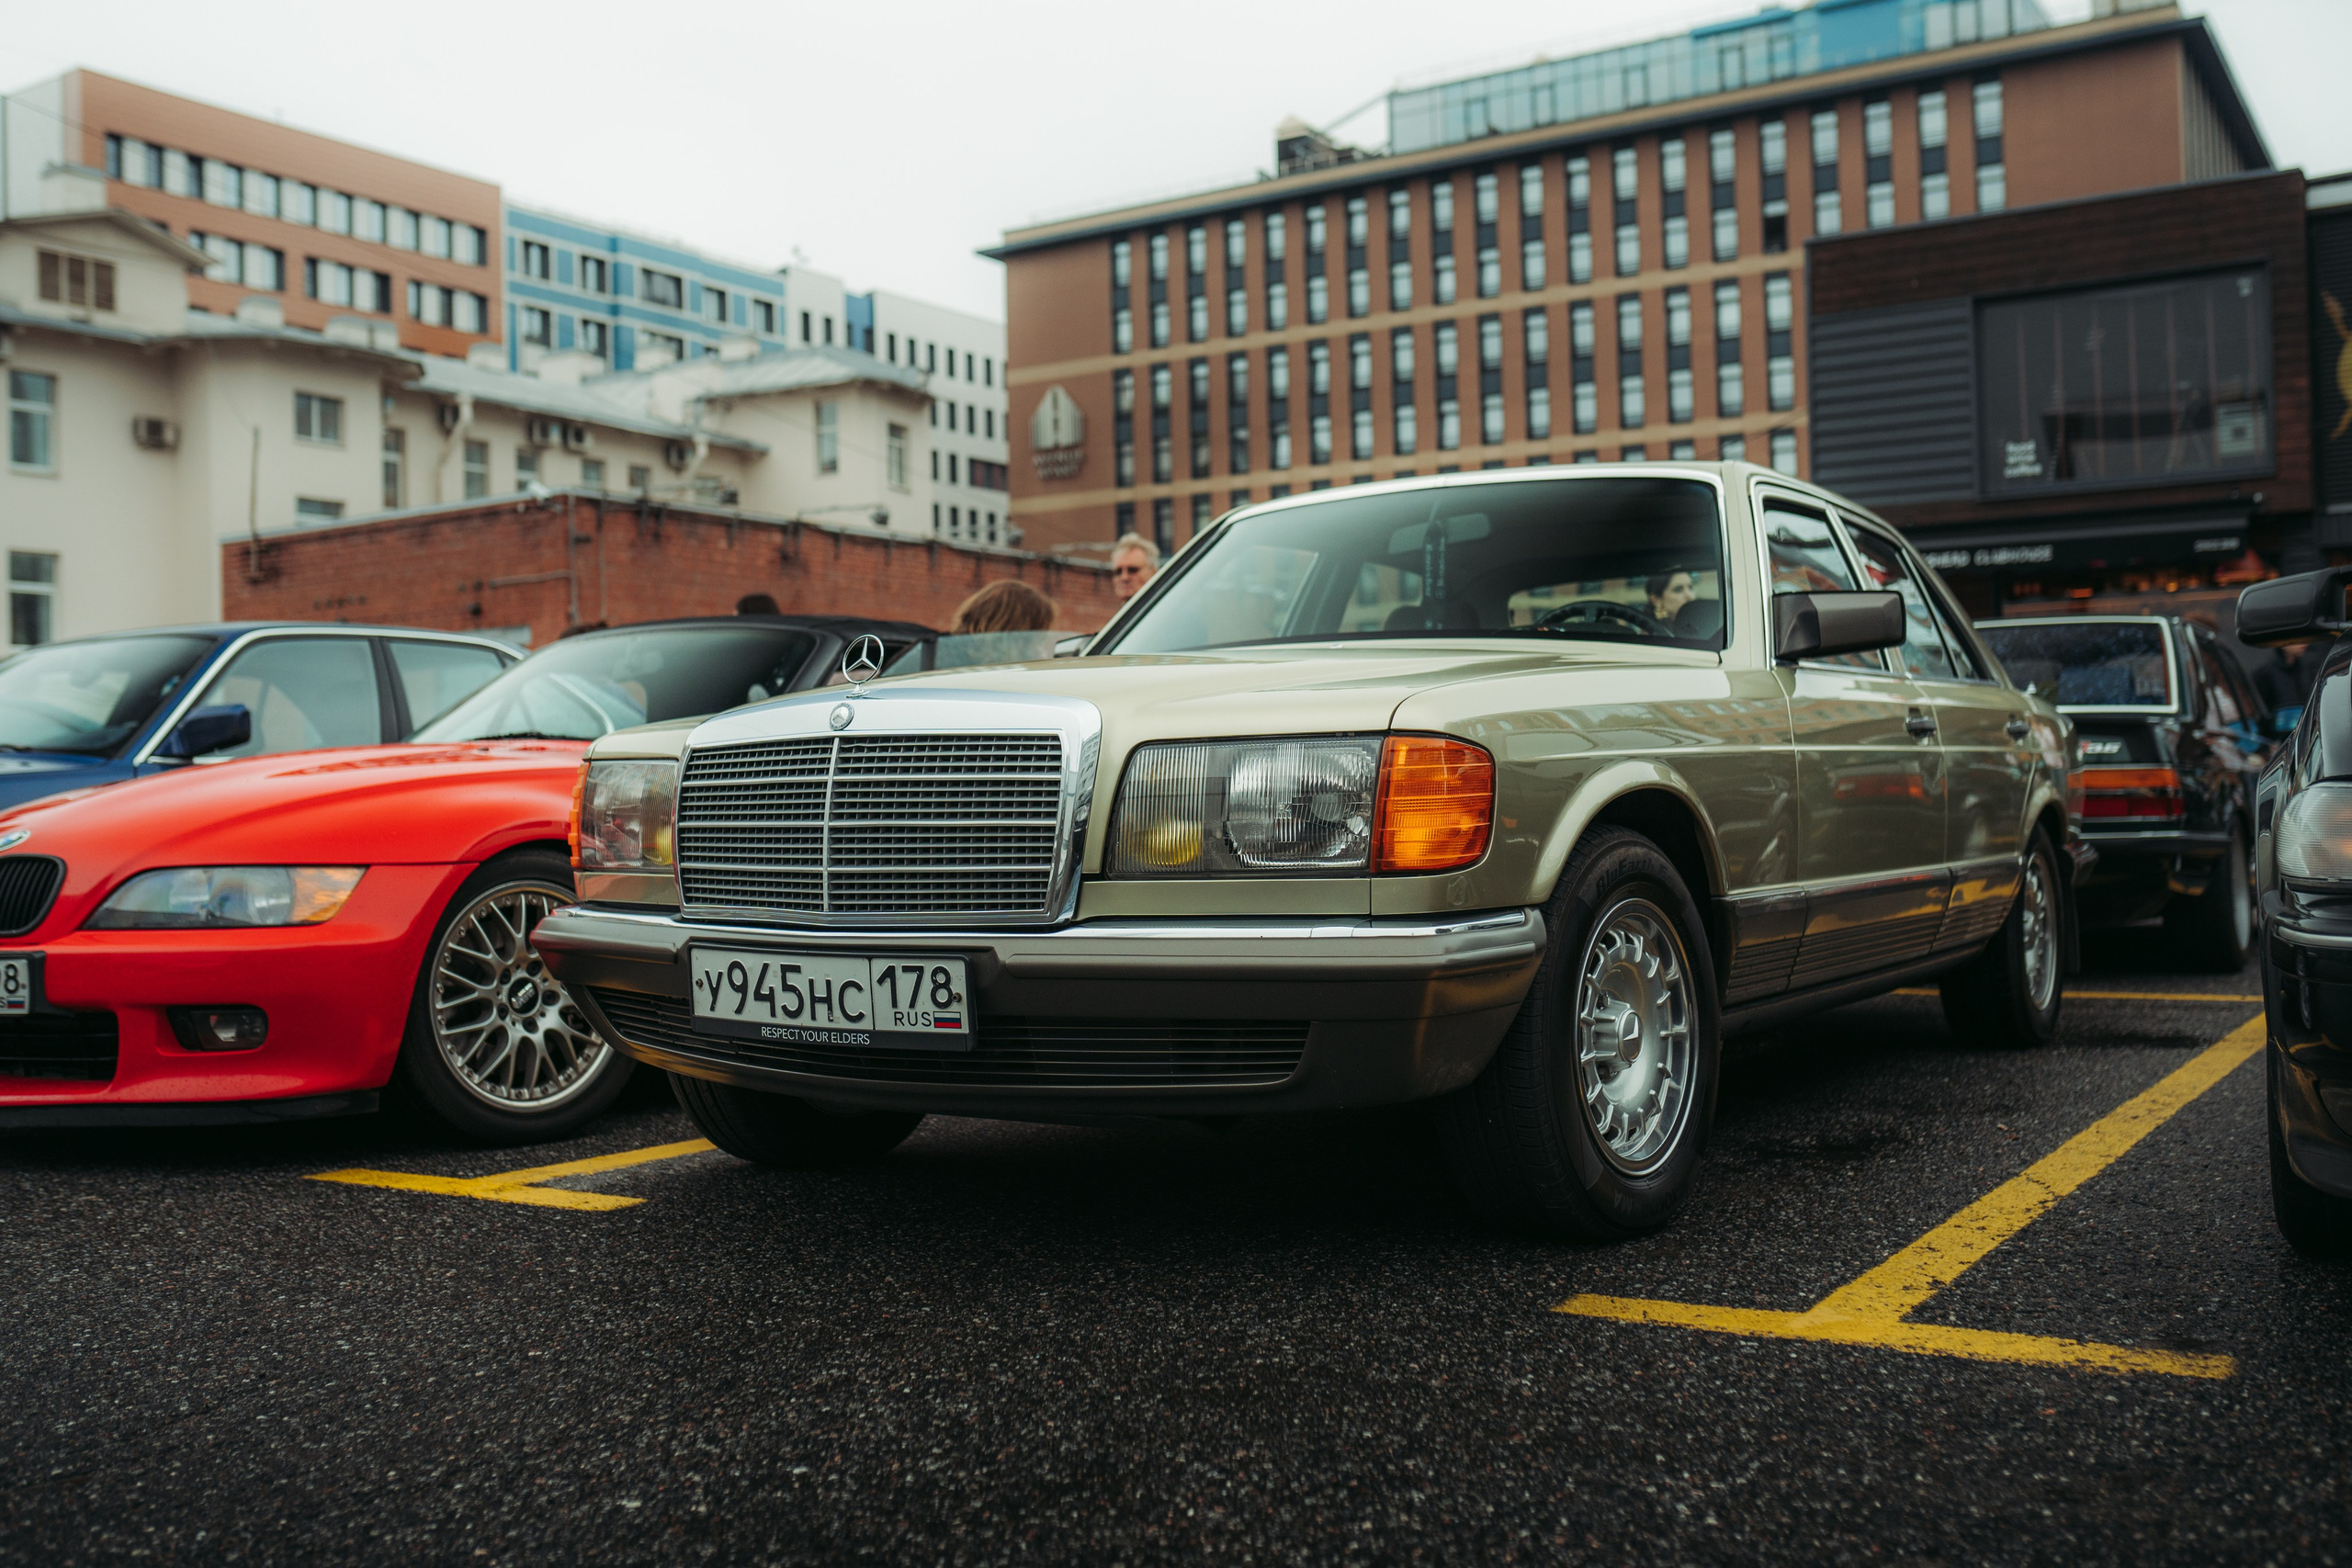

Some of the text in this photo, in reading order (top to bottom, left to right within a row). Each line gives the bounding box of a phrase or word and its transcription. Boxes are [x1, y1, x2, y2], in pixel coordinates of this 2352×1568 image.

[876, 964, 954, 1010] 178
[894, 1010, 933, 1028] RUS
[761, 1026, 870, 1045] RESPECT YOUR ELDERS
